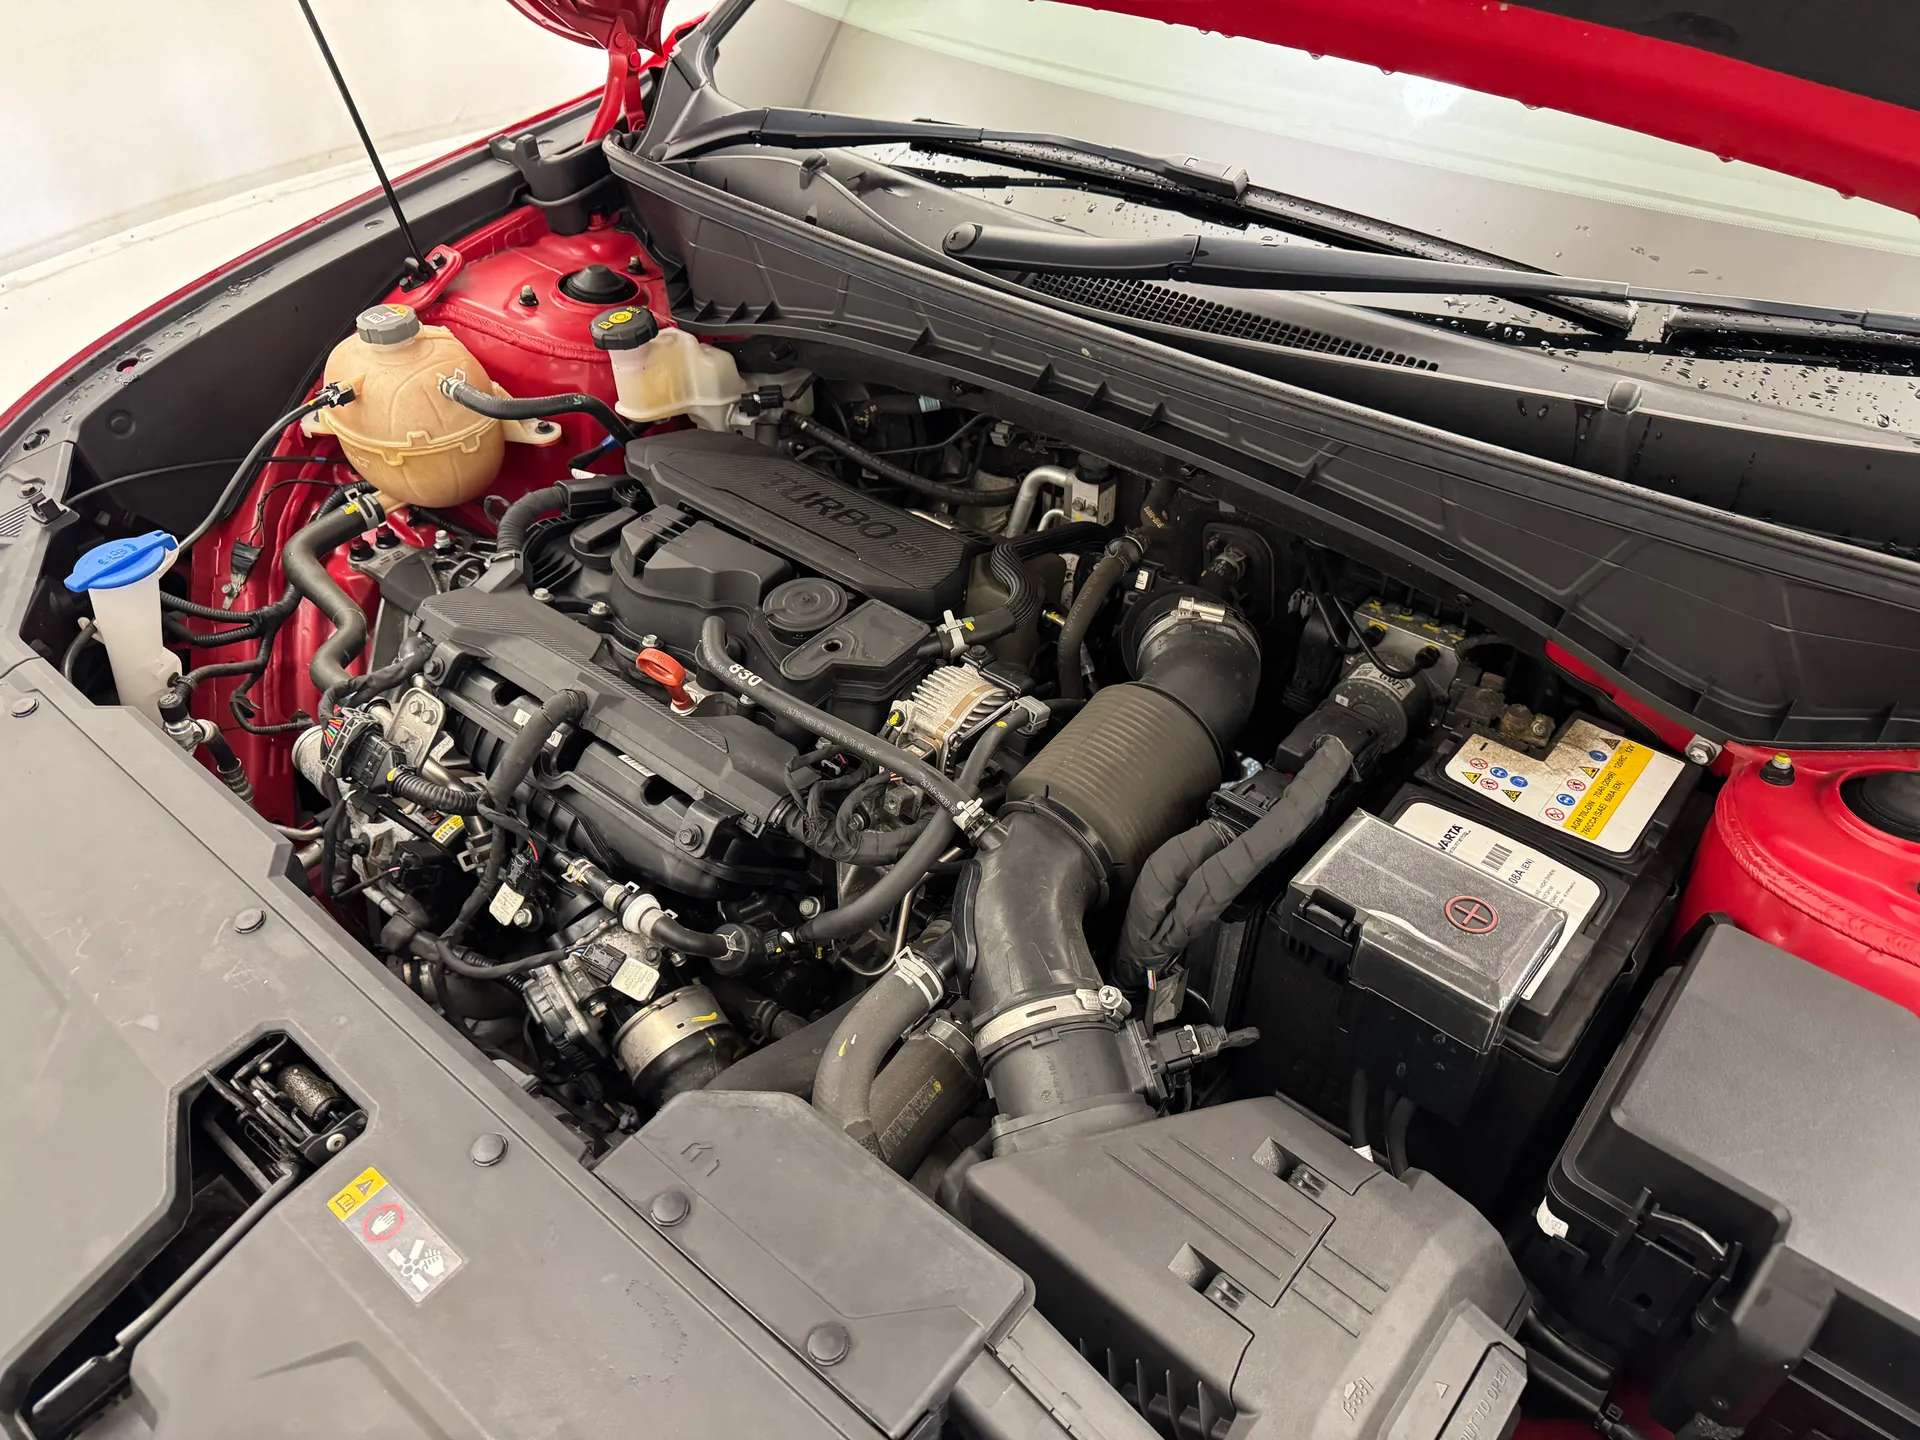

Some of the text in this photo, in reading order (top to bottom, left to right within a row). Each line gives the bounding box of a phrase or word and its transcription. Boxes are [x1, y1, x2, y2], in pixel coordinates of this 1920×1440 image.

[729, 663, 763, 686] 830
[1438, 824, 1463, 851] VARTA
[1508, 858, 1535, 885] 08A (EN)
[1474, 1399, 1492, 1418] TO
[1487, 1363, 1514, 1400] OPEN
